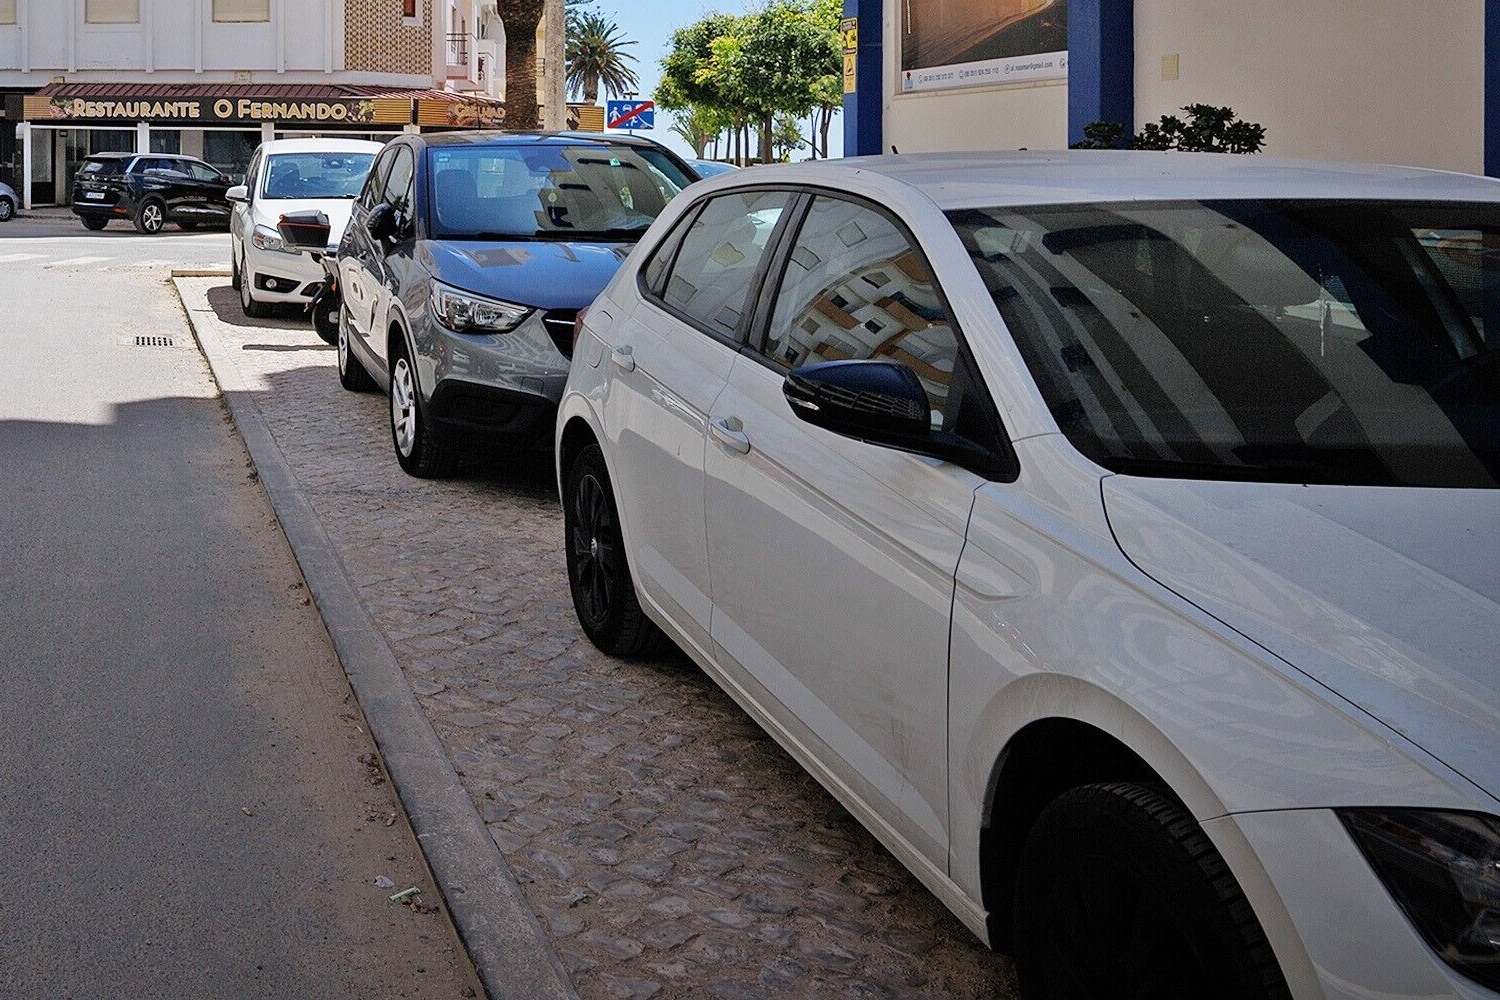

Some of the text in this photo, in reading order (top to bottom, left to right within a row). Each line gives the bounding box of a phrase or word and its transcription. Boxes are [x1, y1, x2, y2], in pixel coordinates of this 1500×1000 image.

[73, 98, 348, 120] RESTAURANTE O FERNANDO
